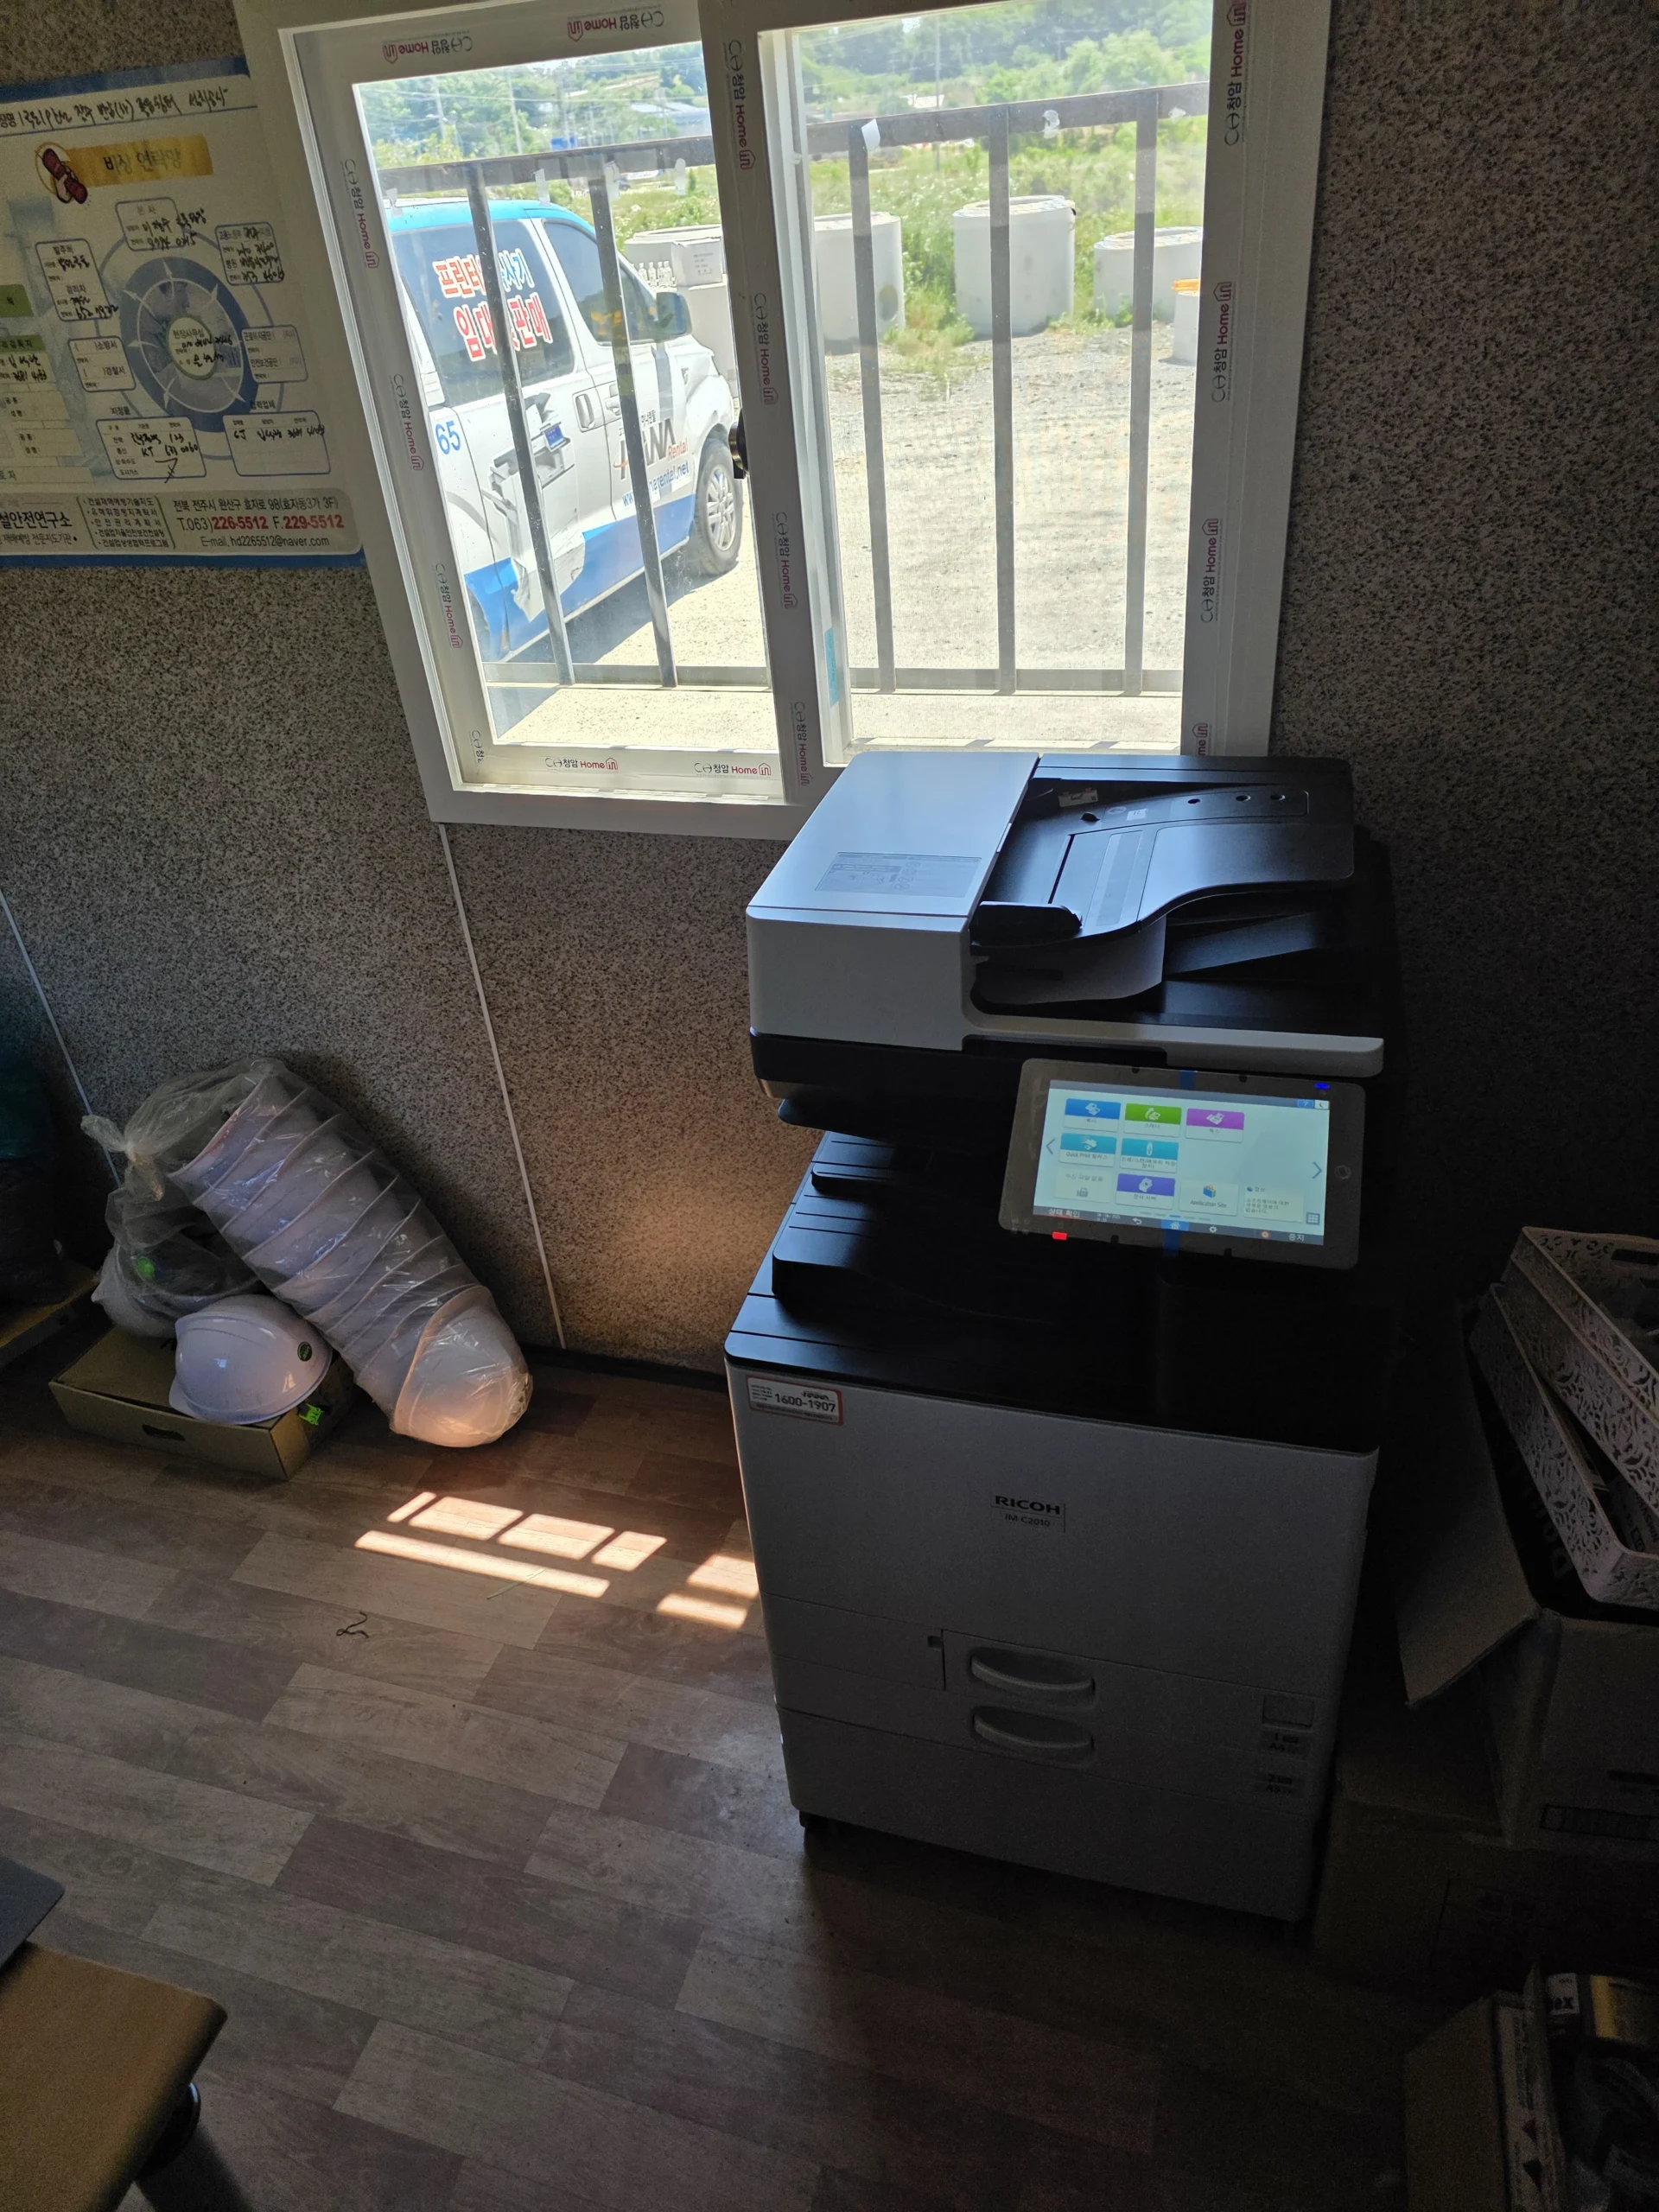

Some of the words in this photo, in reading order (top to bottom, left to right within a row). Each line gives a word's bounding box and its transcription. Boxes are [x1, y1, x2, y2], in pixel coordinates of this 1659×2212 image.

[584, 17, 616, 30] Home
[398, 43, 429, 54] Home
[1230, 30, 1244, 77] Home
[735, 105, 748, 148] Home
[103, 155, 132, 175] 비상
[357, 213, 370, 249] Home
[1217, 302, 1230, 345] Home
[760, 349, 771, 385] Home
[404, 422, 416, 454] Home
[435, 420, 461, 454] 65
[142, 446, 154, 457] KT
[668, 436, 689, 461] Rental
[173, 499, 188, 512] 전북
[192, 499, 216, 512] 전주시
[219, 498, 242, 511] 완산구
[245, 499, 267, 511] 효자로
[323, 496, 339, 509] 3F)
[0, 511, 73, 529] 설안전연구소
[230, 535, 330, 547] hd2265512@naver.com
[1205, 537, 1217, 573] Home
[781, 561, 791, 592] Home
[444, 605, 457, 632] Home
[798, 741, 808, 772] Home
[1198, 739, 1207, 756] me
[580, 760, 605, 769] Home
[731, 766, 757, 774] Home
[1288, 1233, 1304, 1242] 중지
[774, 1393, 836, 1413] 1600-1907
[995, 1496, 1060, 1515] RICOH
[1020, 1516, 1051, 1527] C2010
